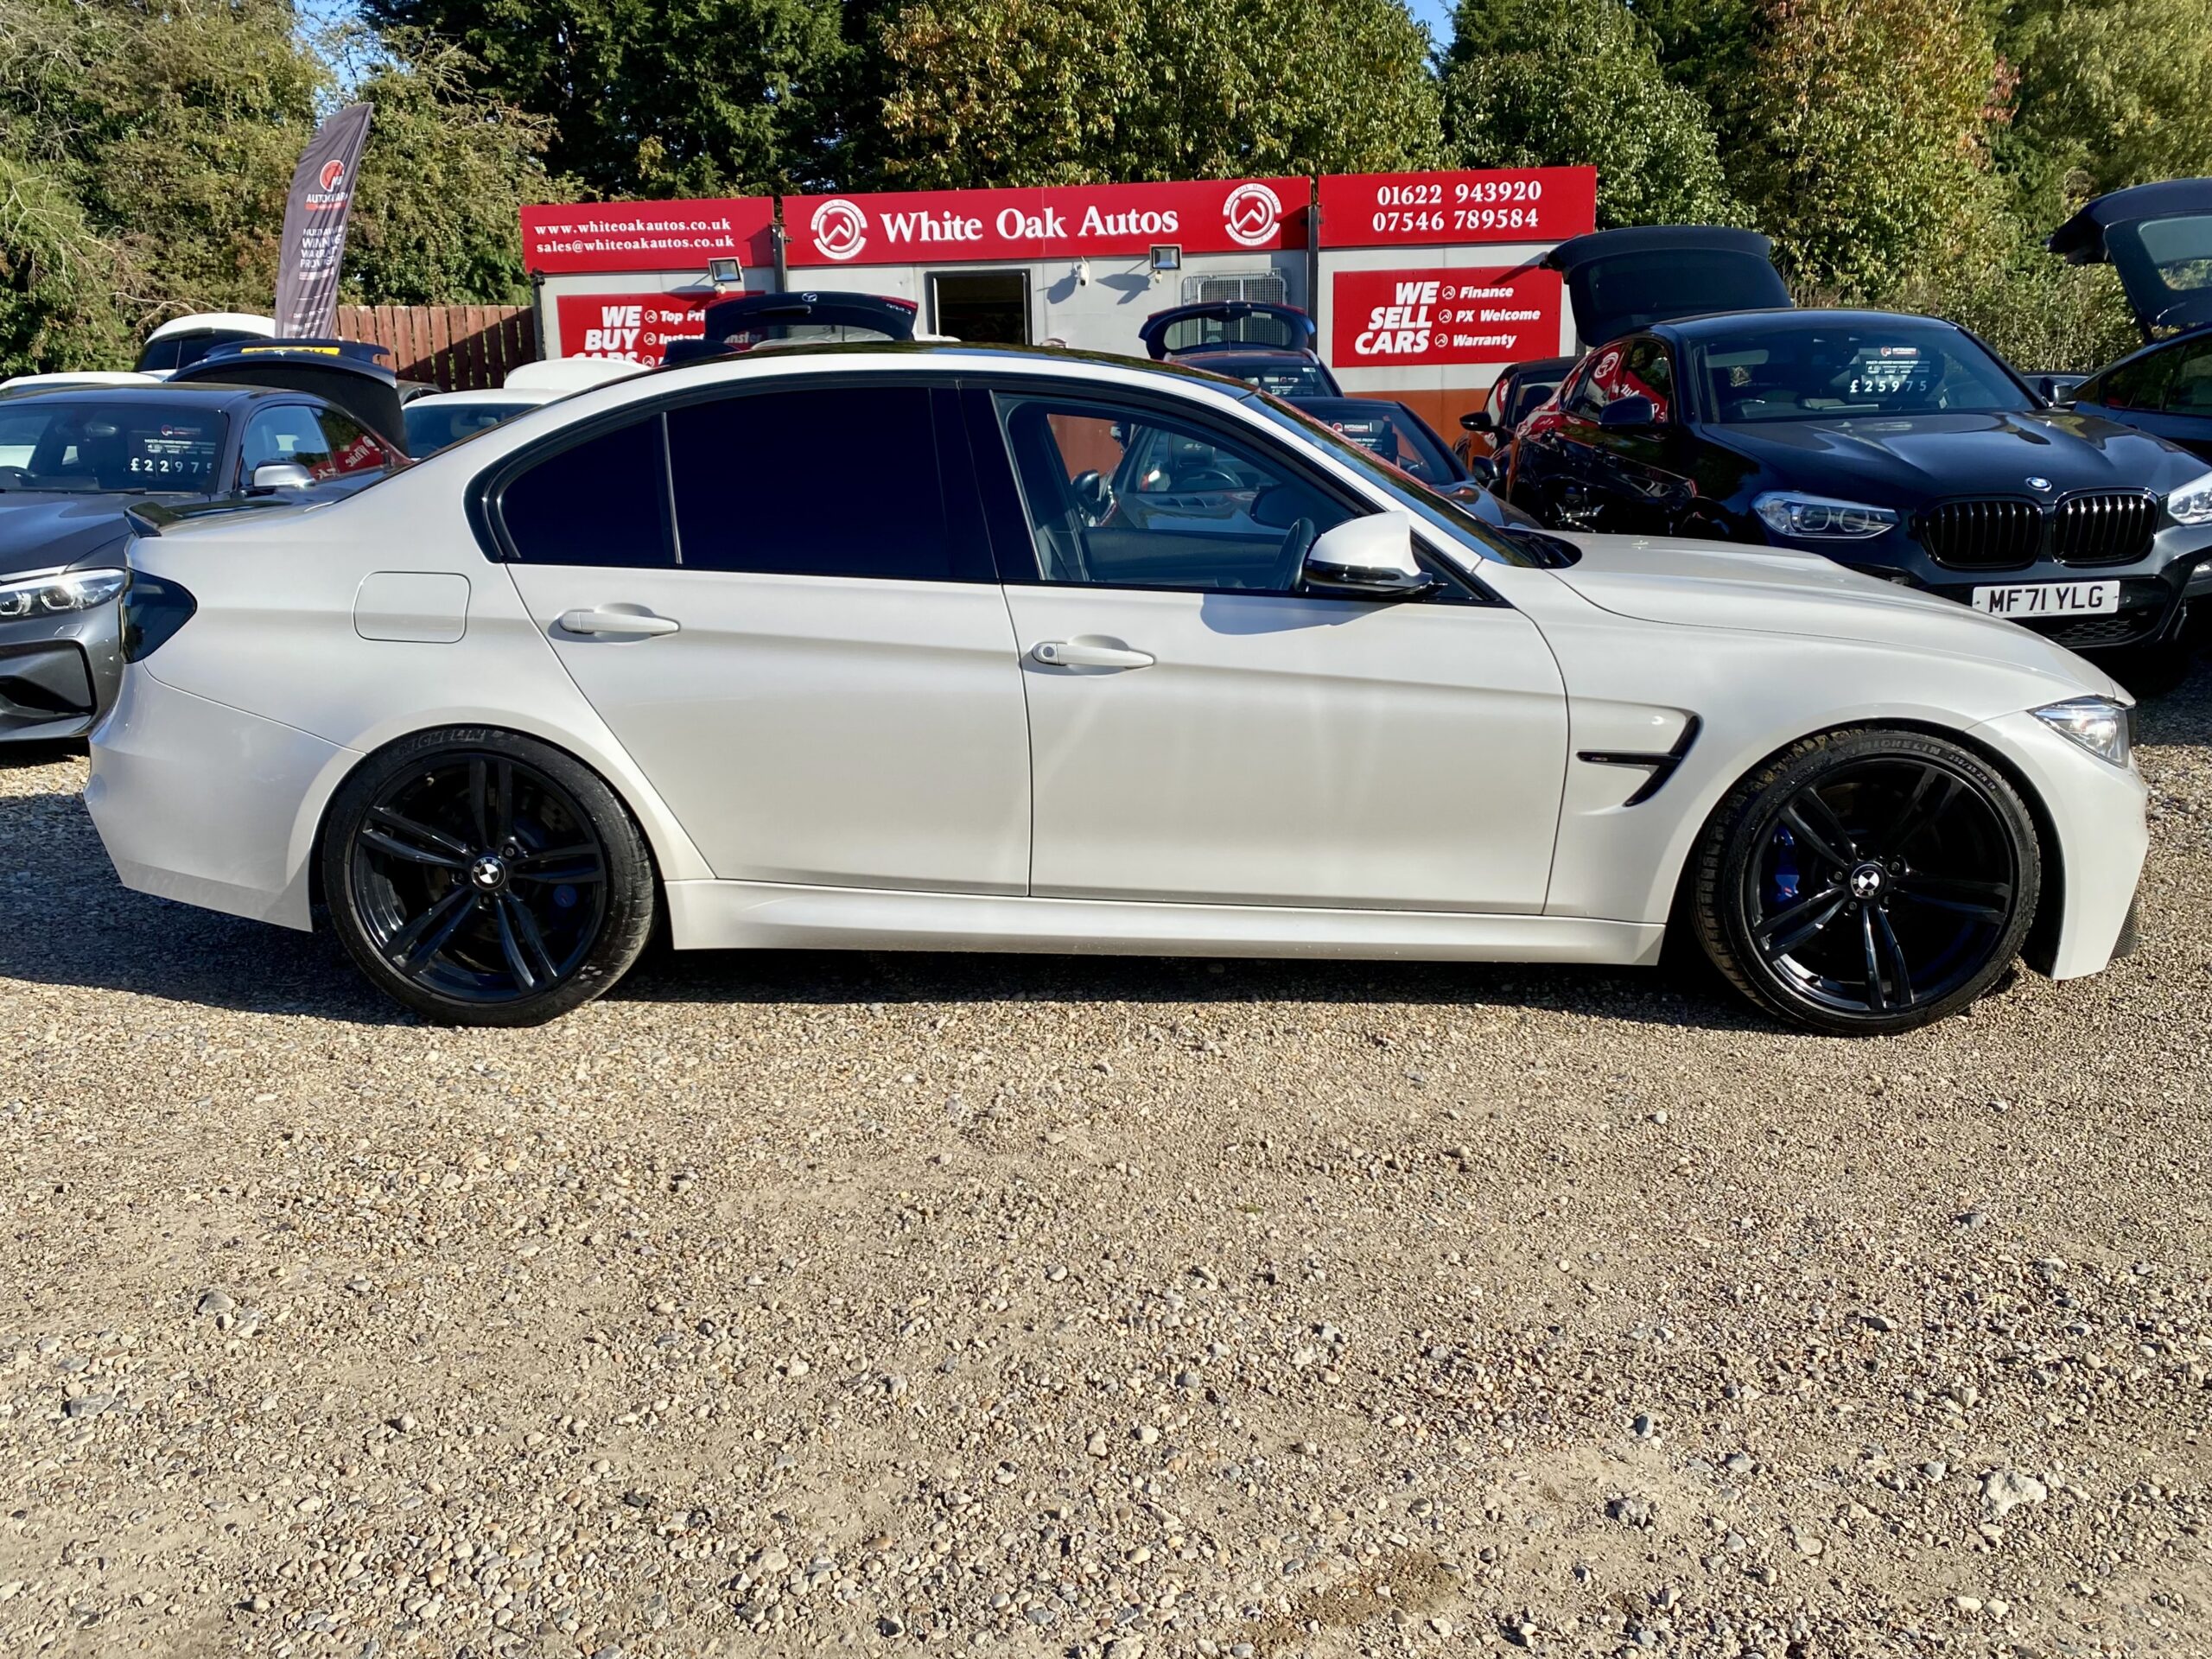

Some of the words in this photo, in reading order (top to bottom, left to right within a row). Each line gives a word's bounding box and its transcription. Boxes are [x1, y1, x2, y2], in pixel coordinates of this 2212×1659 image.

[1376, 184, 1442, 206] 01622
[1455, 181, 1542, 203] 943920
[534, 218, 733, 236] www.whiteoakautos.co.uk
[879, 211, 983, 243] White
[995, 207, 1068, 240] Oak
[1077, 206, 1179, 237] Autos
[1372, 211, 1445, 232] 07546
[1453, 208, 1539, 230] 789584
[536, 235, 735, 253] sales@whiteoakautos.co.uk
[1395, 281, 1440, 305] WE
[1459, 286, 1514, 299] Finance
[601, 305, 643, 328] WE
[659, 310, 683, 325] Top
[1368, 305, 1433, 330] SELL
[1455, 309, 1475, 323] PX
[1480, 308, 1541, 322] Welcome
[584, 328, 640, 351] BUY
[1354, 329, 1430, 355] CARS
[1452, 334, 1517, 349] Warranty
[1989, 588, 2047, 613] MF71
[2056, 585, 2104, 610] YLG
[1858, 738, 1942, 756] MICHELIN
